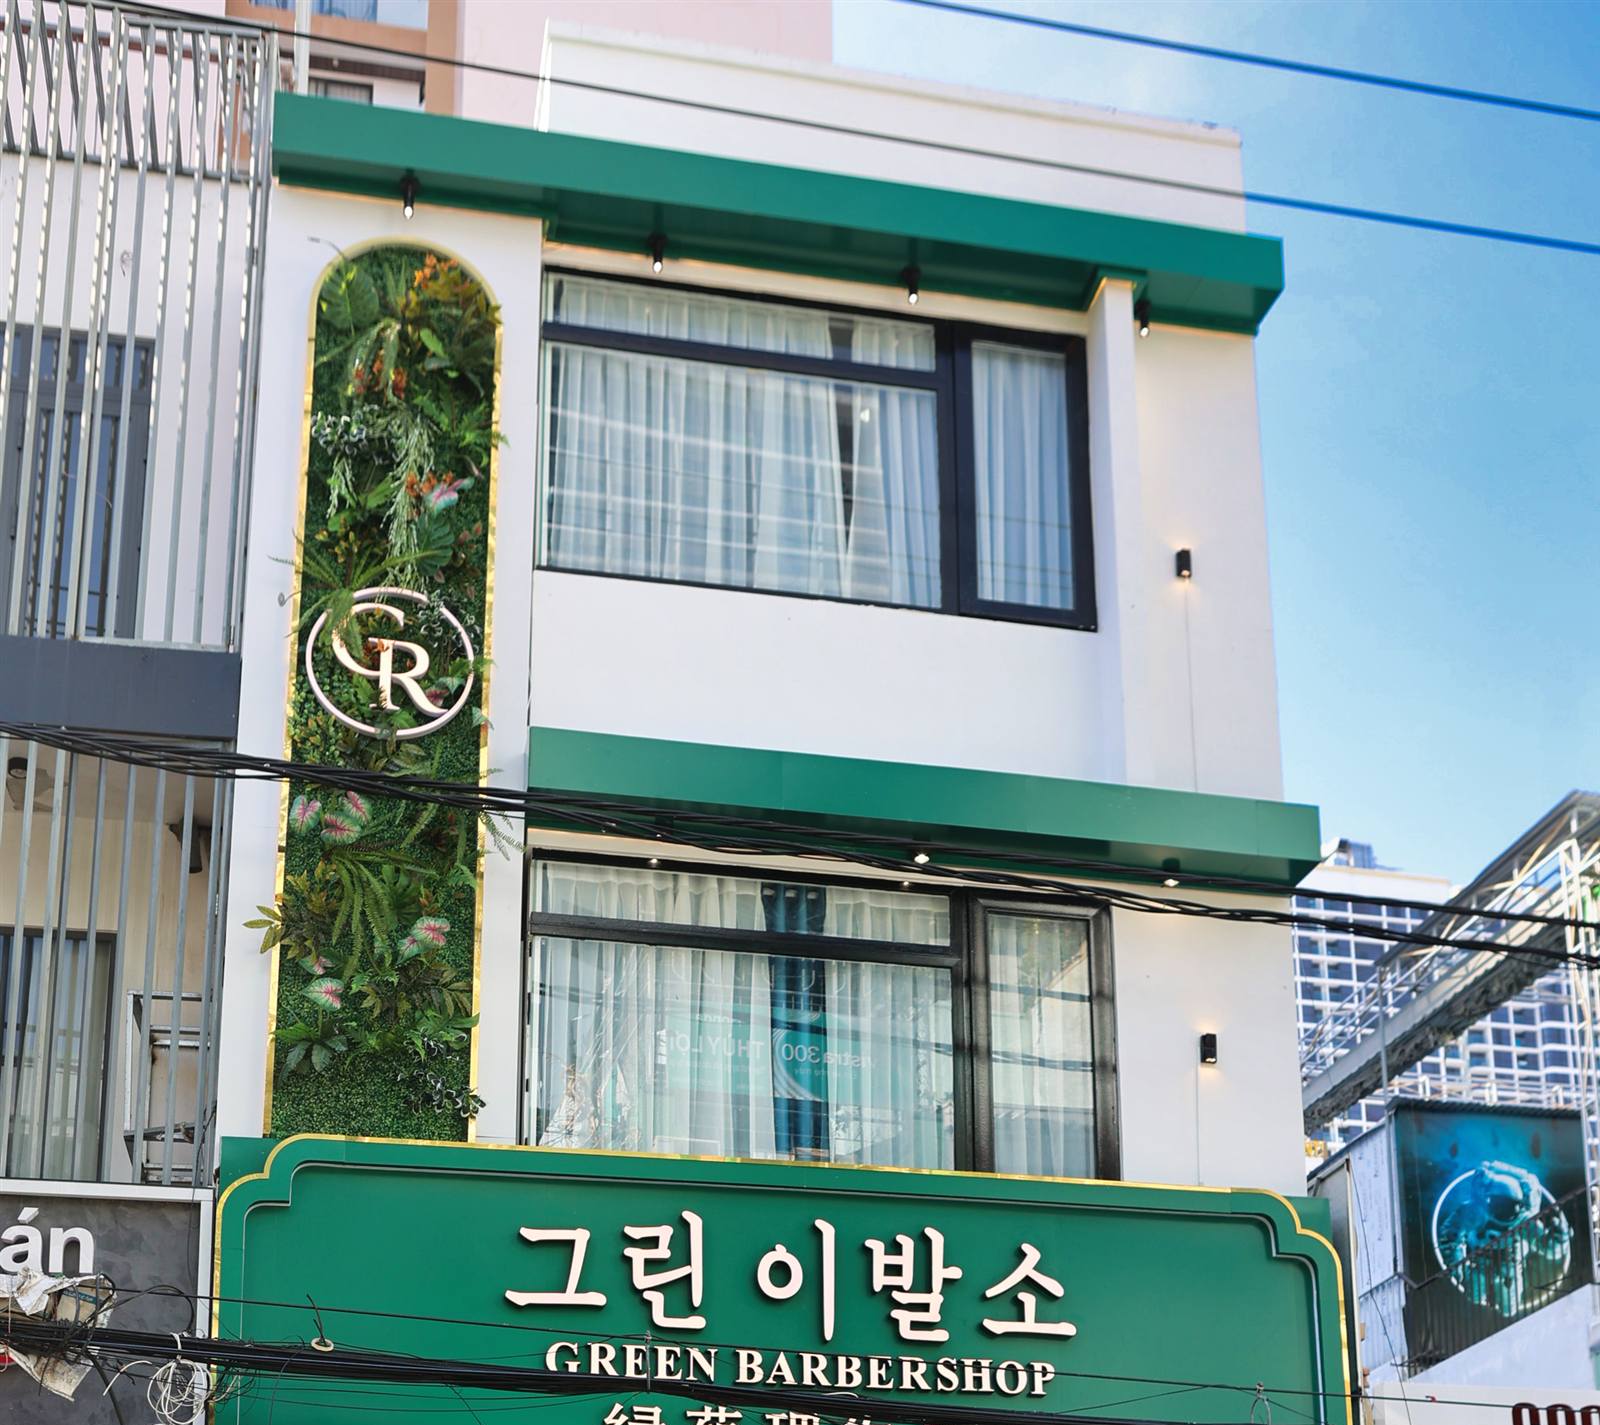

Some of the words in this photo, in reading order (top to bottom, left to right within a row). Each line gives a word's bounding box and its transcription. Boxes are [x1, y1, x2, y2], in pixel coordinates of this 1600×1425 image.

[504, 1209, 707, 1331] 그린
[756, 1218, 1078, 1343] 이발소
[545, 1341, 718, 1384] GREEN
[735, 1349, 1056, 1396] BARBERSHOP
